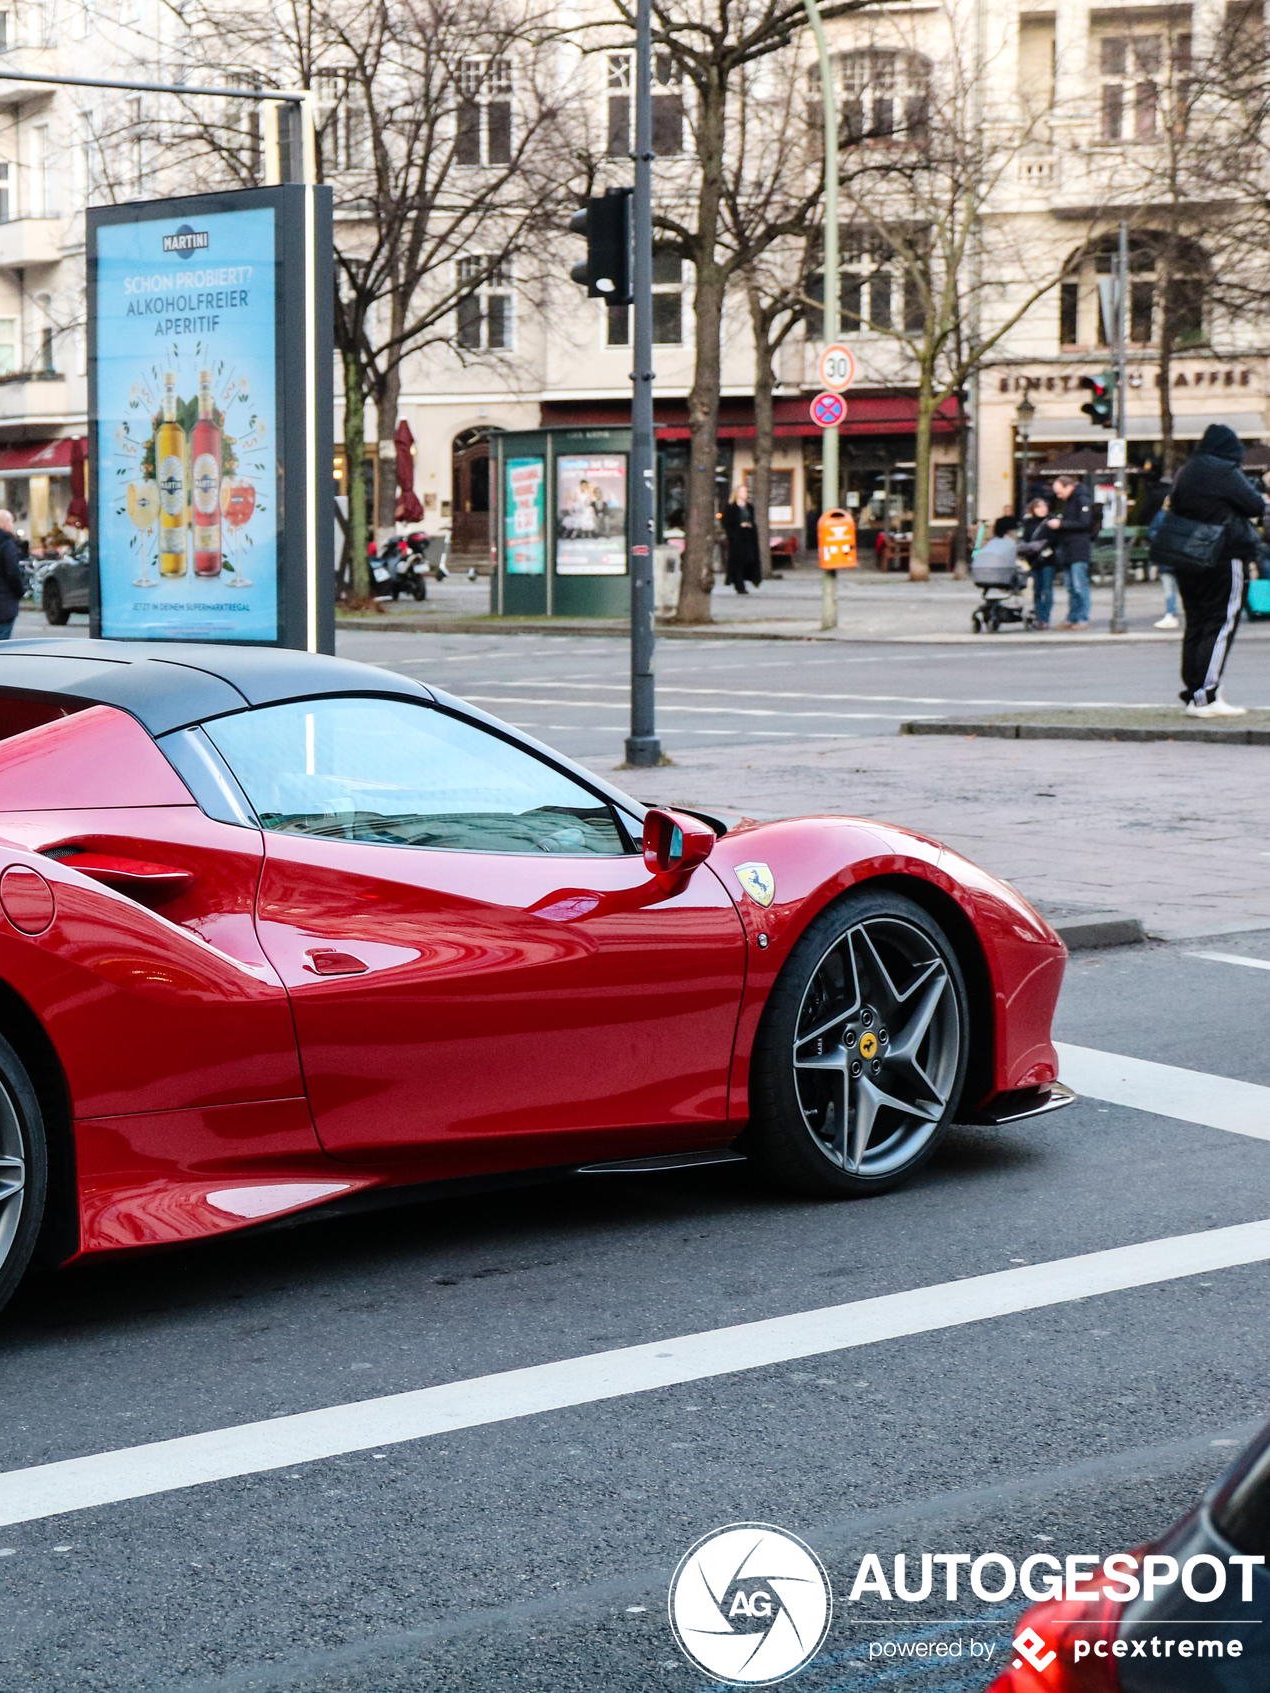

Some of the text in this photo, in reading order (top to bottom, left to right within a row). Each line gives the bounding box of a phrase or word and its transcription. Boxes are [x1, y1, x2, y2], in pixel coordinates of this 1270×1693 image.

[163, 233, 208, 250] MARTINI
[124, 266, 253, 295] SCHON PROBIERT?
[154, 315, 220, 336] APERITIF
[827, 358, 847, 378] 30
[132, 603, 250, 611] JETZT IN DEINEM SUPERMARKTREGAL
